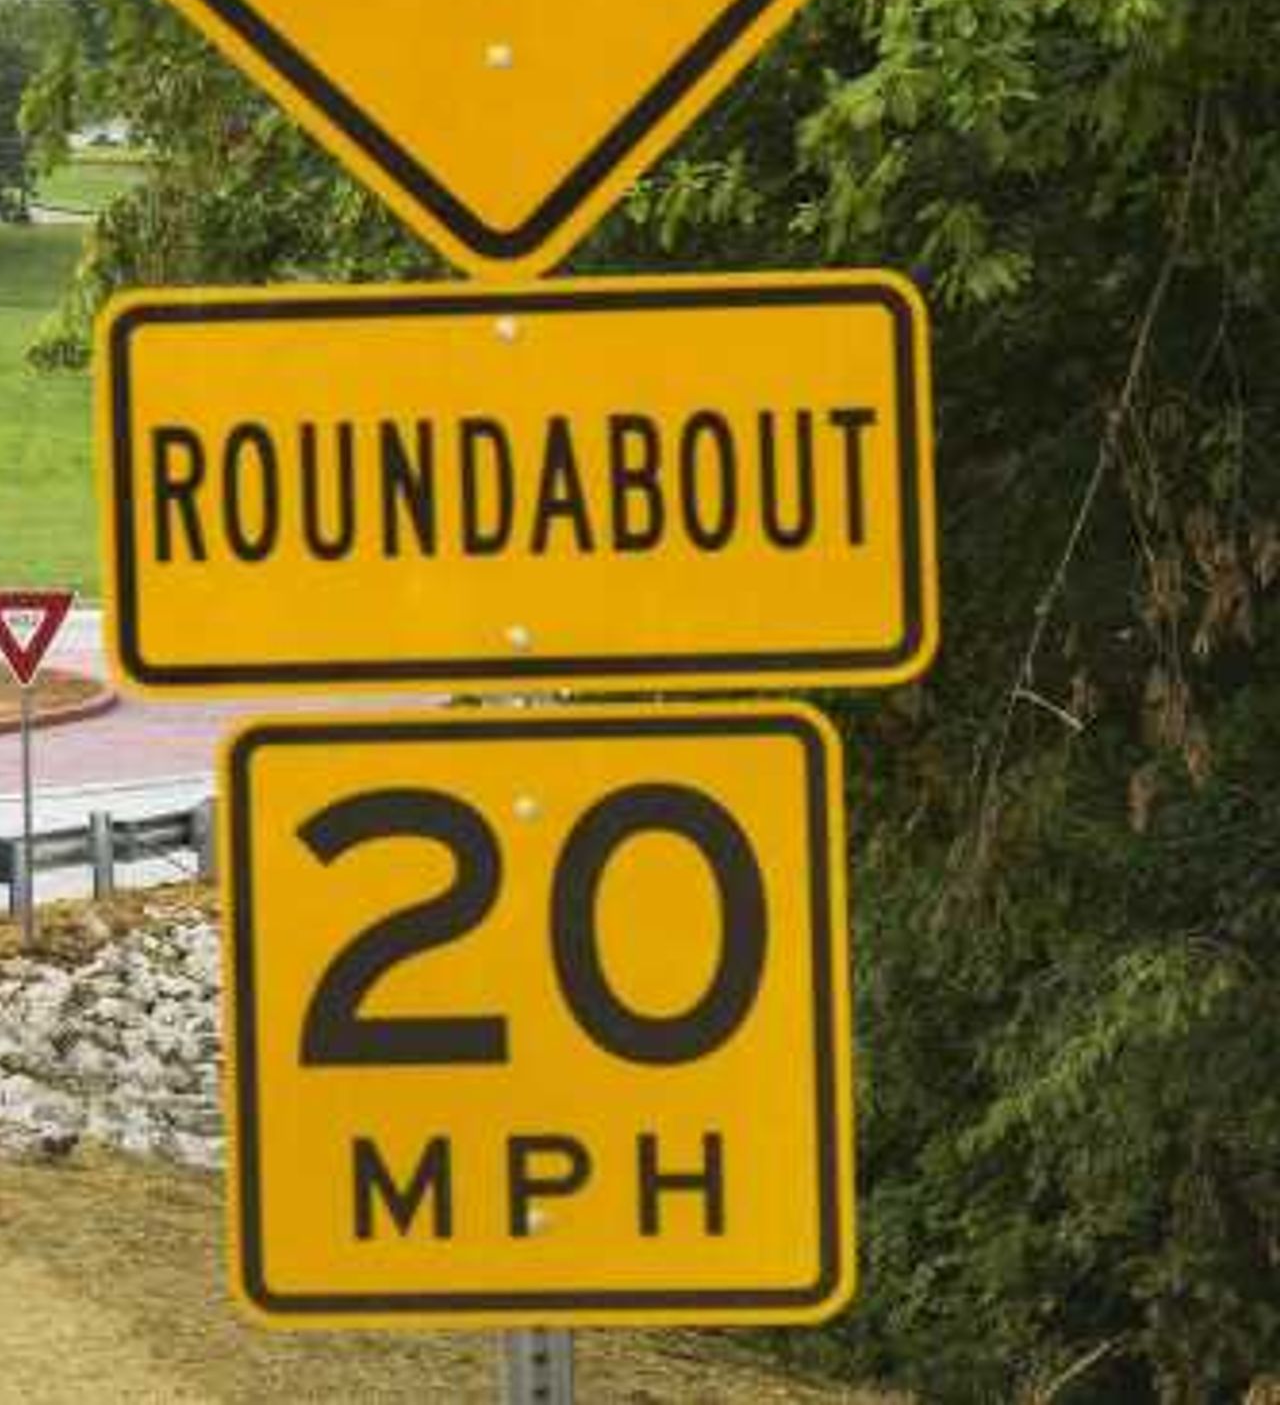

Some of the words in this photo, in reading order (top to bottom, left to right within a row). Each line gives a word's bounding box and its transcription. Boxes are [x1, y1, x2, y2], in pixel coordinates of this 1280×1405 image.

[152, 407, 877, 563] ROUNDABOUT
[296, 783, 770, 1068] 20
[353, 1132, 726, 1240] MPH
